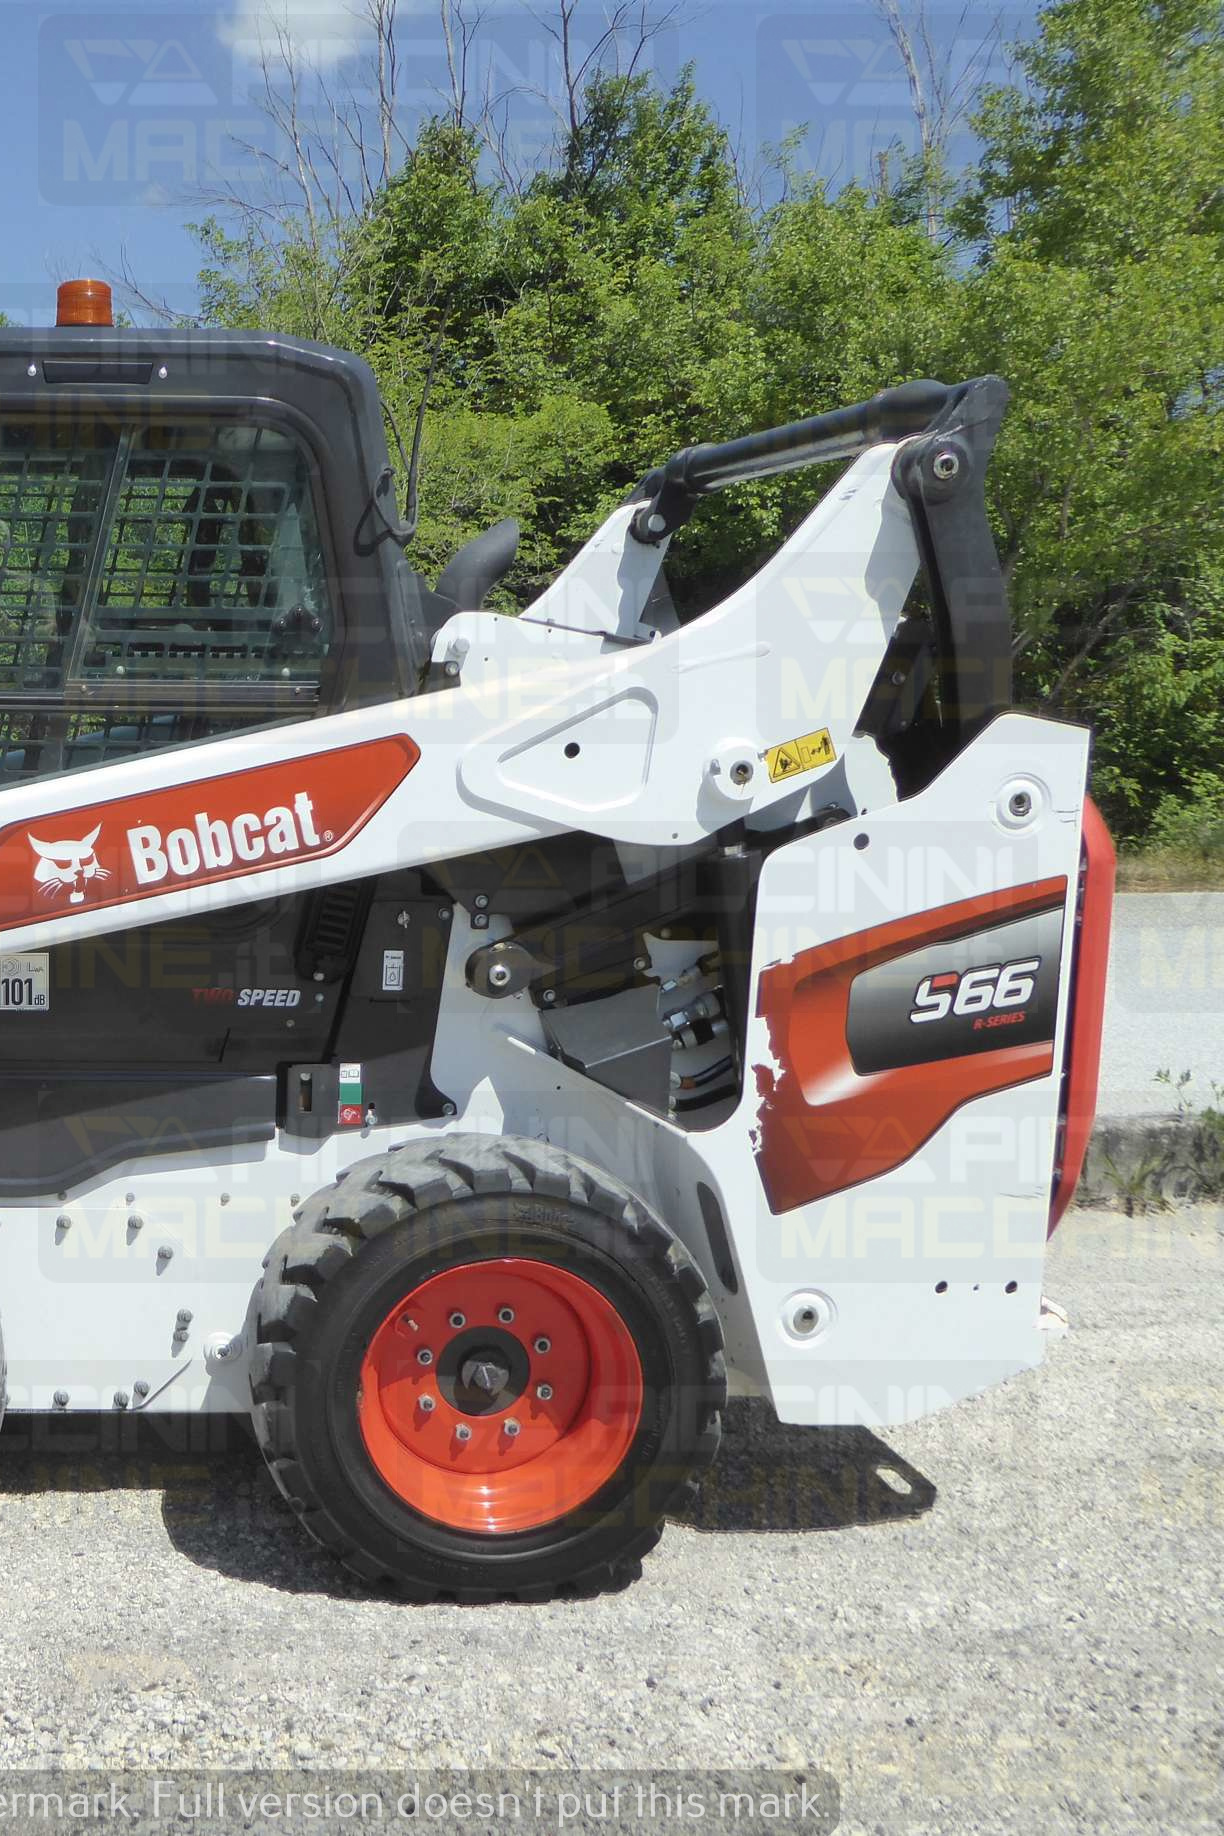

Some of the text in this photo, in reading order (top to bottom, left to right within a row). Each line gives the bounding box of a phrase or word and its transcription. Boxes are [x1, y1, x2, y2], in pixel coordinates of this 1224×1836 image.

[127, 791, 321, 884] Bobcat
[1, 978, 46, 1006] 101 dB
[192, 987, 301, 1007] TWO SPEED
[909, 955, 1042, 1024] S66
[973, 1010, 1025, 1031] R-SERIES
